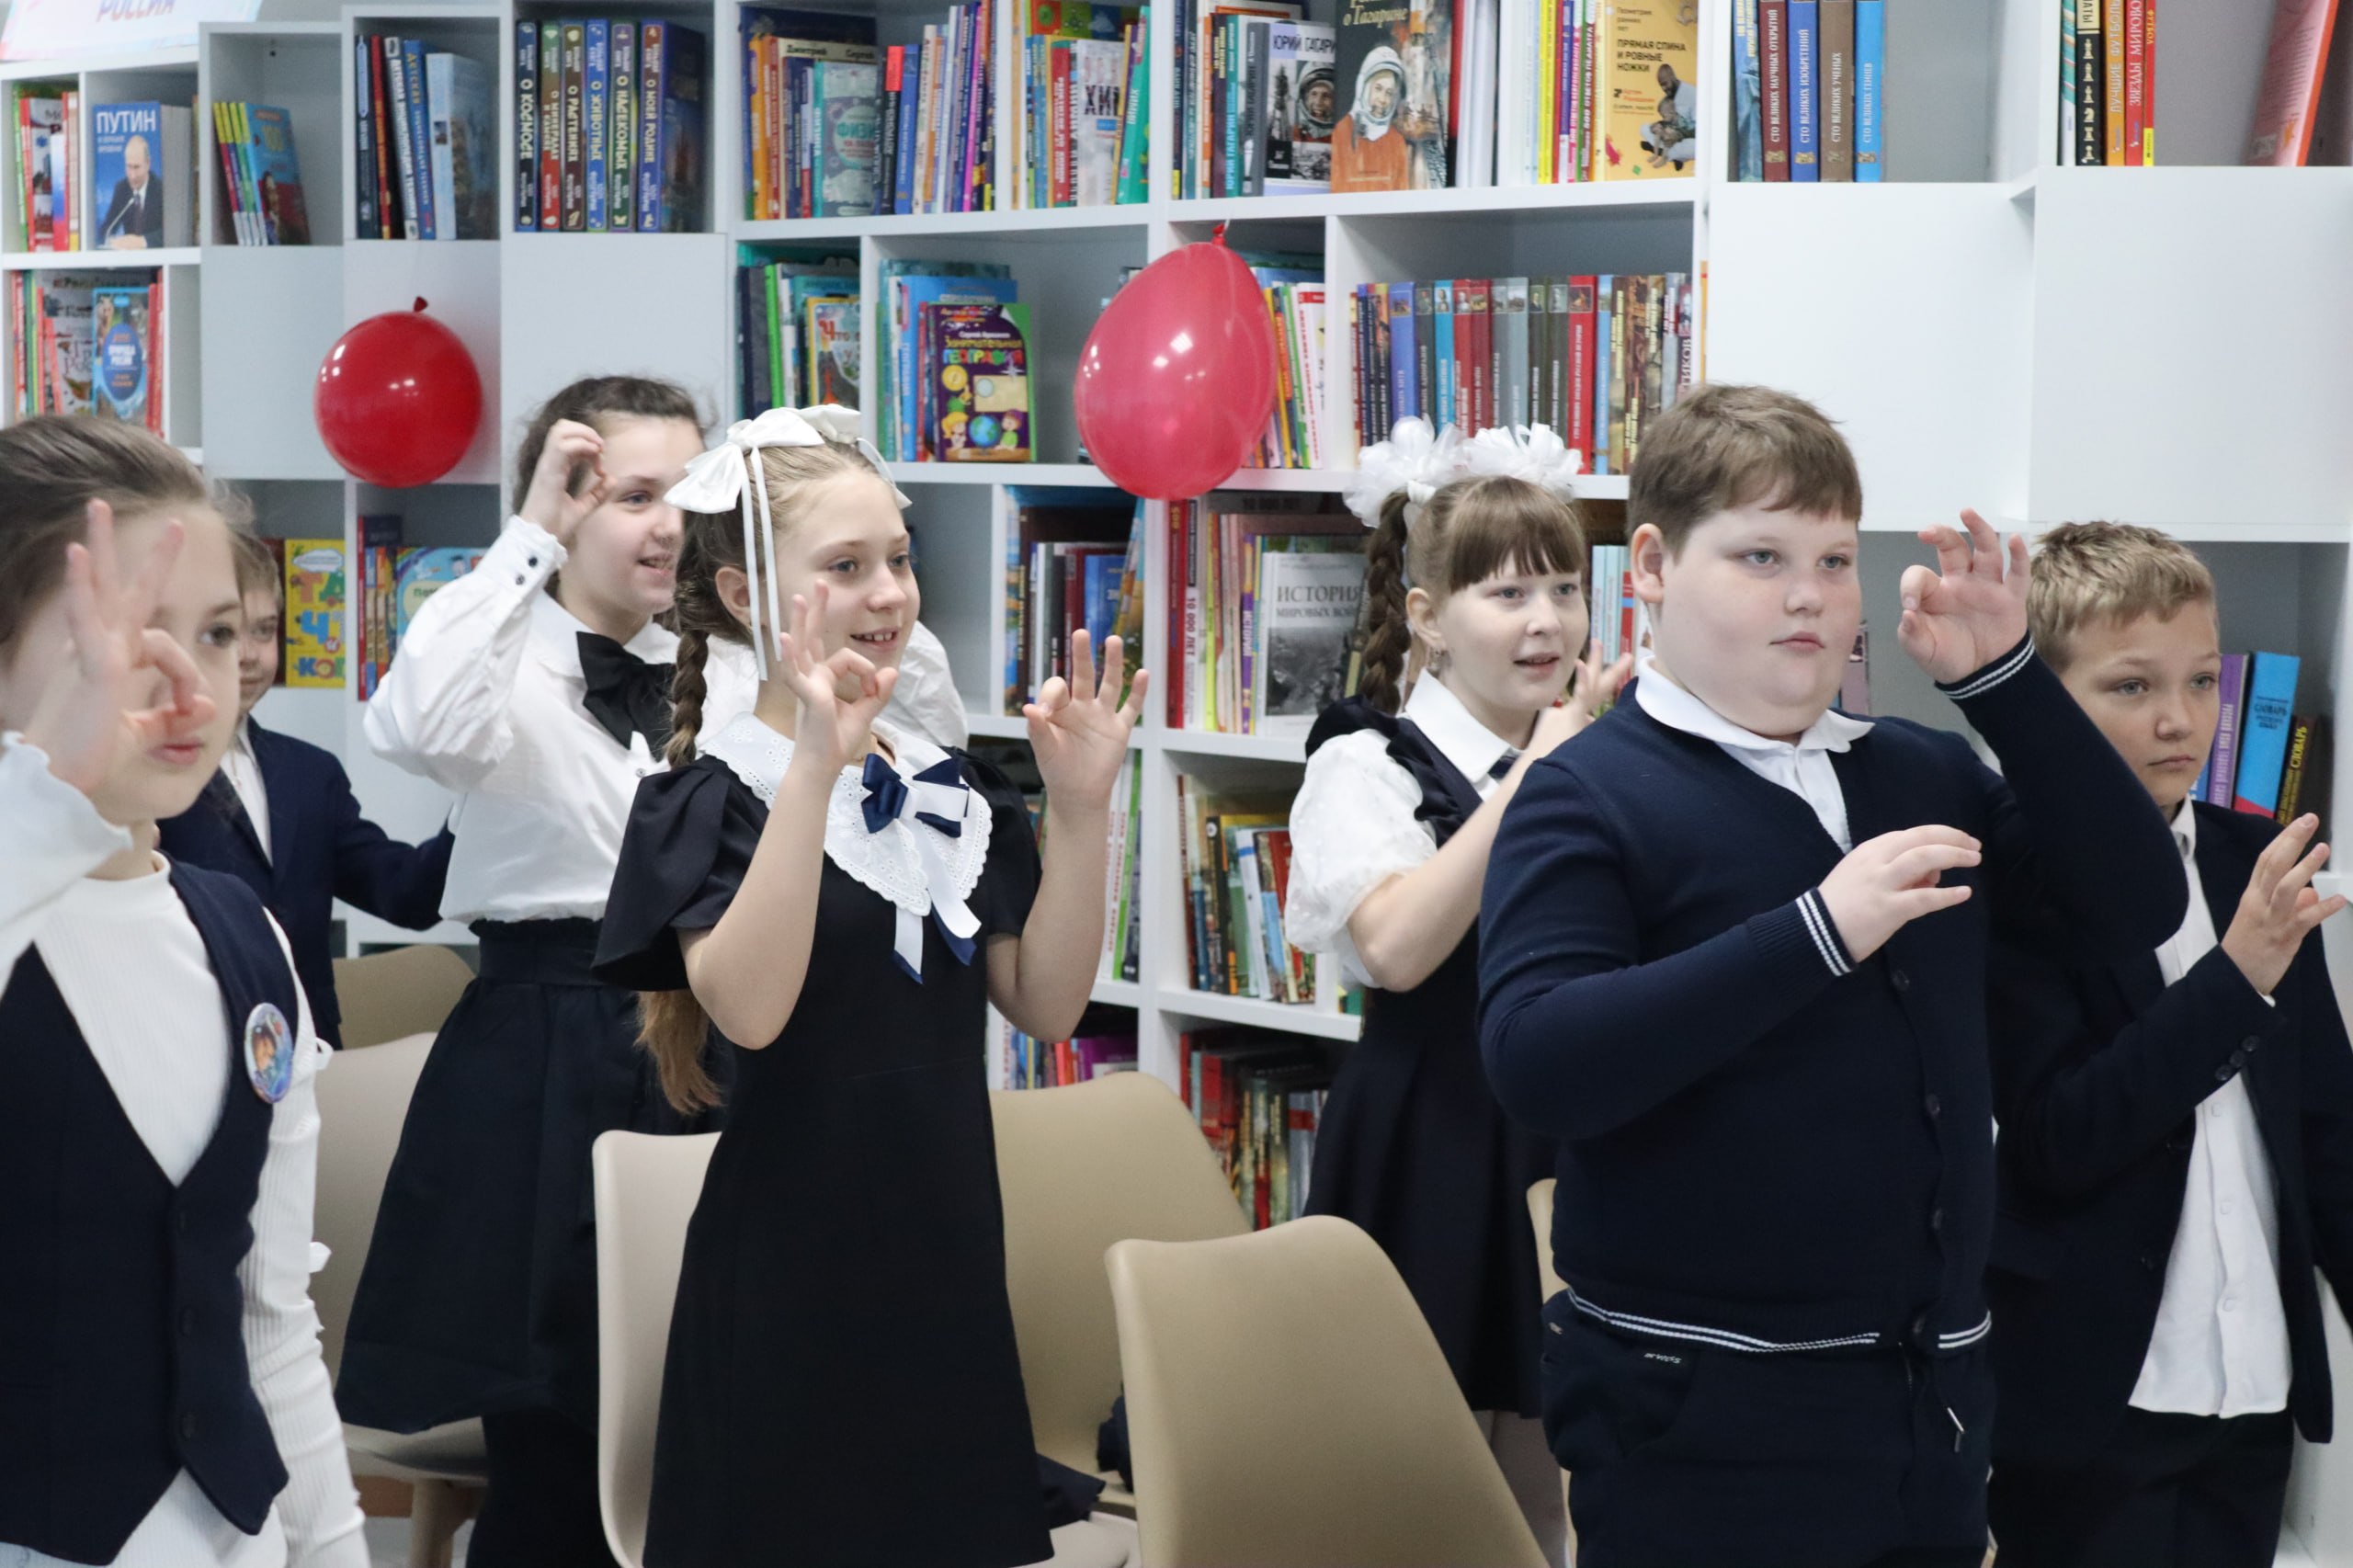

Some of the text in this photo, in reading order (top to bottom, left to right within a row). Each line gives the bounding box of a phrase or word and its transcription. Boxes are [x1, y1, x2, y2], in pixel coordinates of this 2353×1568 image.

[1272, 33, 1302, 51] ЮРИЙ
[1617, 39, 1687, 51] ПРЯМАЯ СПИНА
[2145, 8, 2155, 45] ФУТБОЛ
[1617, 62, 1650, 72] НОЖКИ
[1625, 51, 1664, 62] РОВНЫЕ
[1767, 9, 1780, 142] СТО ВЕЛИКИХ НАУЧНЫХ ОТКРЫТИЙ
[1798, 28, 1810, 143] СТО ВЕЛИКИХ ИЗОБРЕТЕНИЙ
[1831, 52, 1842, 142] СТО ВЕЛИКИХ УЧЕНЫХ
[2109, 63, 2121, 112] ЛУЧШИЕ
[2129, 62, 2143, 107] ЗВЕЗДЫ
[97, 109, 156, 134] ПУТИН
[520, 78, 533, 160] О КОСМОСЕ
[567, 85, 579, 162] О РАСТЕНИЯХ
[590, 80, 602, 161] О ЖИВОТНЫХ
[616, 74, 629, 170] О НАСЕКОМЫХ
[644, 79, 657, 163] О МОЕЙ РОДИНЕ
[1862, 93, 1872, 126] ВЕЛИКИХ
[1225, 114, 1236, 157] ГАГАРИН
[1862, 130, 1872, 143] СТО
[1225, 159, 1236, 190] ЮРИЙ
[942, 348, 1024, 366] ГЕОГРАФИЯ
[1171, 506, 1180, 529] 500
[1277, 585, 1361, 602] ИСТОРИЯ
[1187, 597, 1196, 656] 10 000 ЛЕТ
[2290, 726, 2309, 768] СЛОВАРЬ
